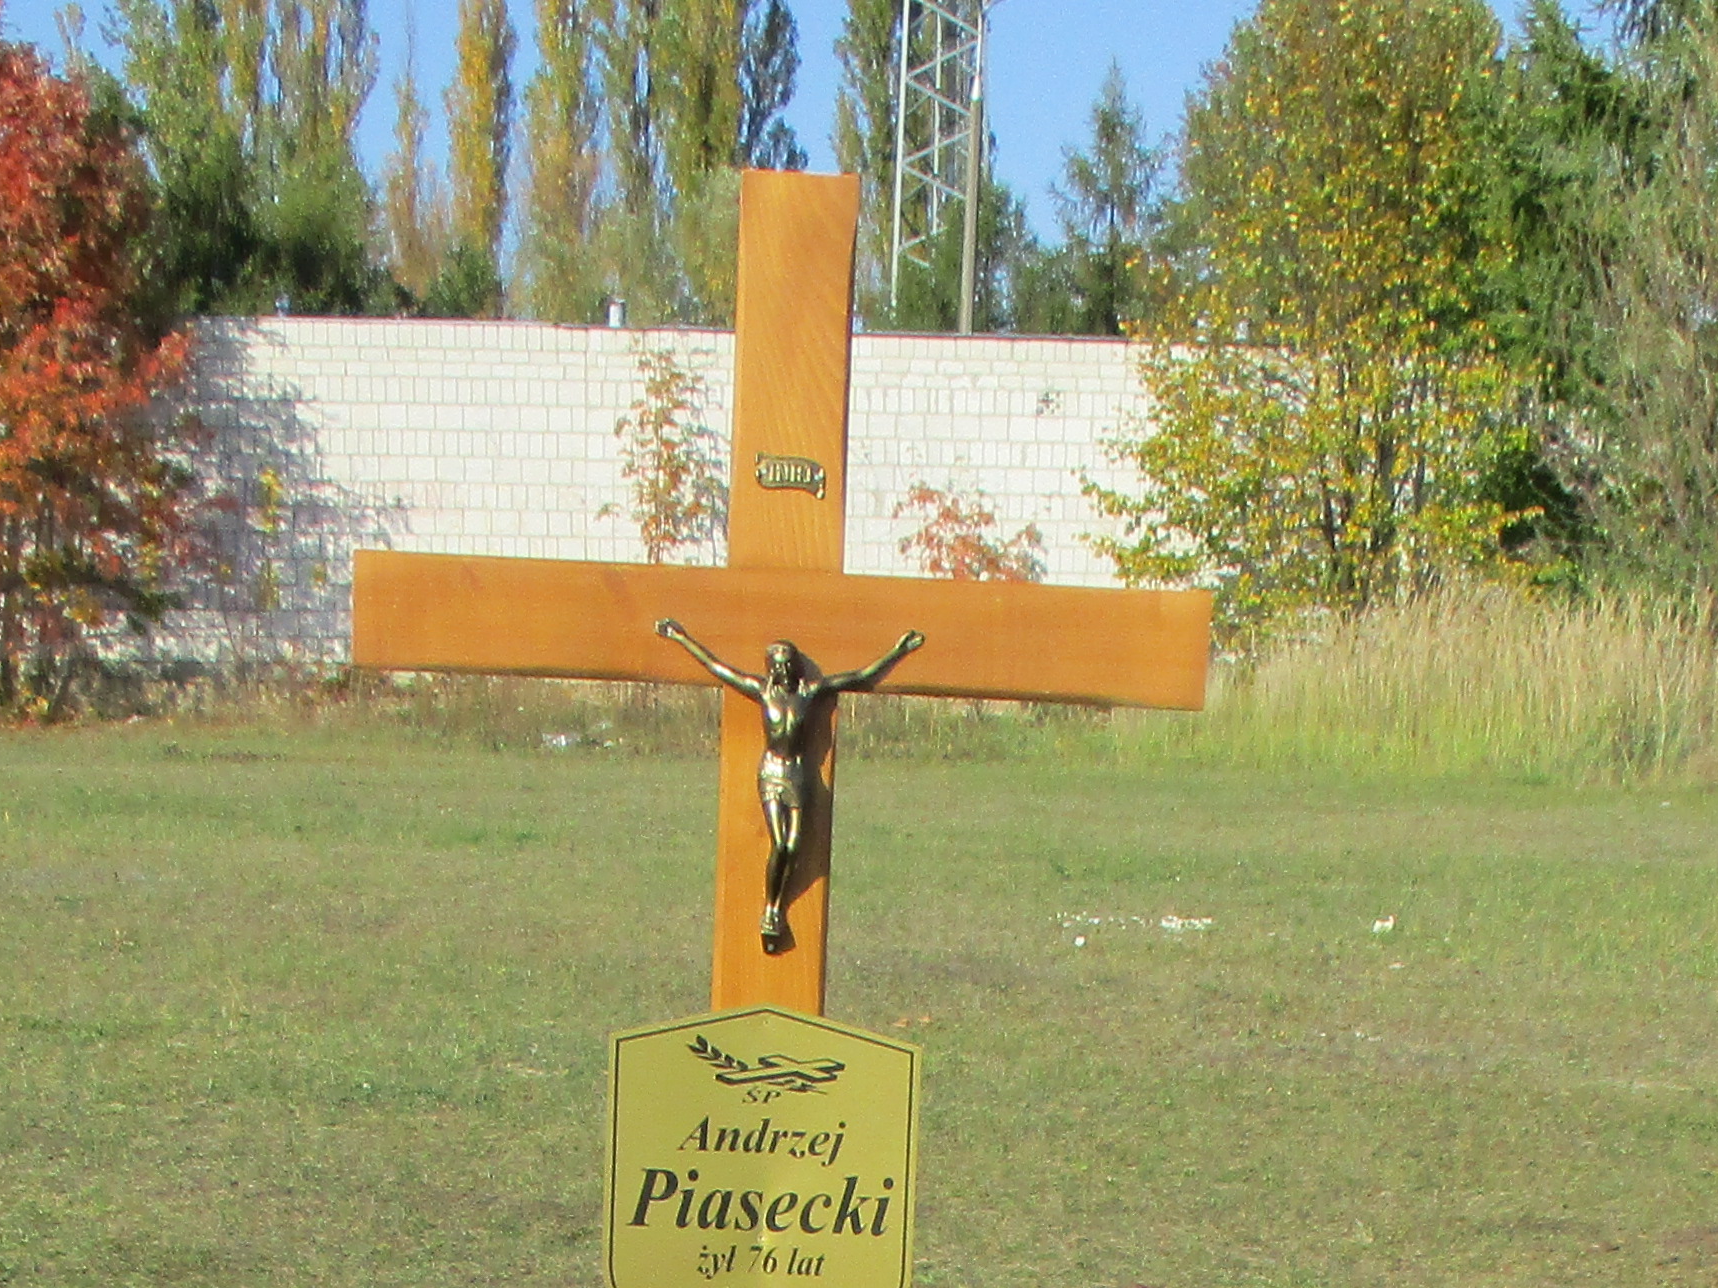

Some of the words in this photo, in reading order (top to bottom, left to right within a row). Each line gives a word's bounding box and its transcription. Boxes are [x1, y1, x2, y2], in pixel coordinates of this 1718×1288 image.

[677, 1115, 848, 1167] Andrzej
[626, 1167, 896, 1238] Piasecki
[748, 1245, 779, 1275] 76
[786, 1247, 826, 1277] lat
